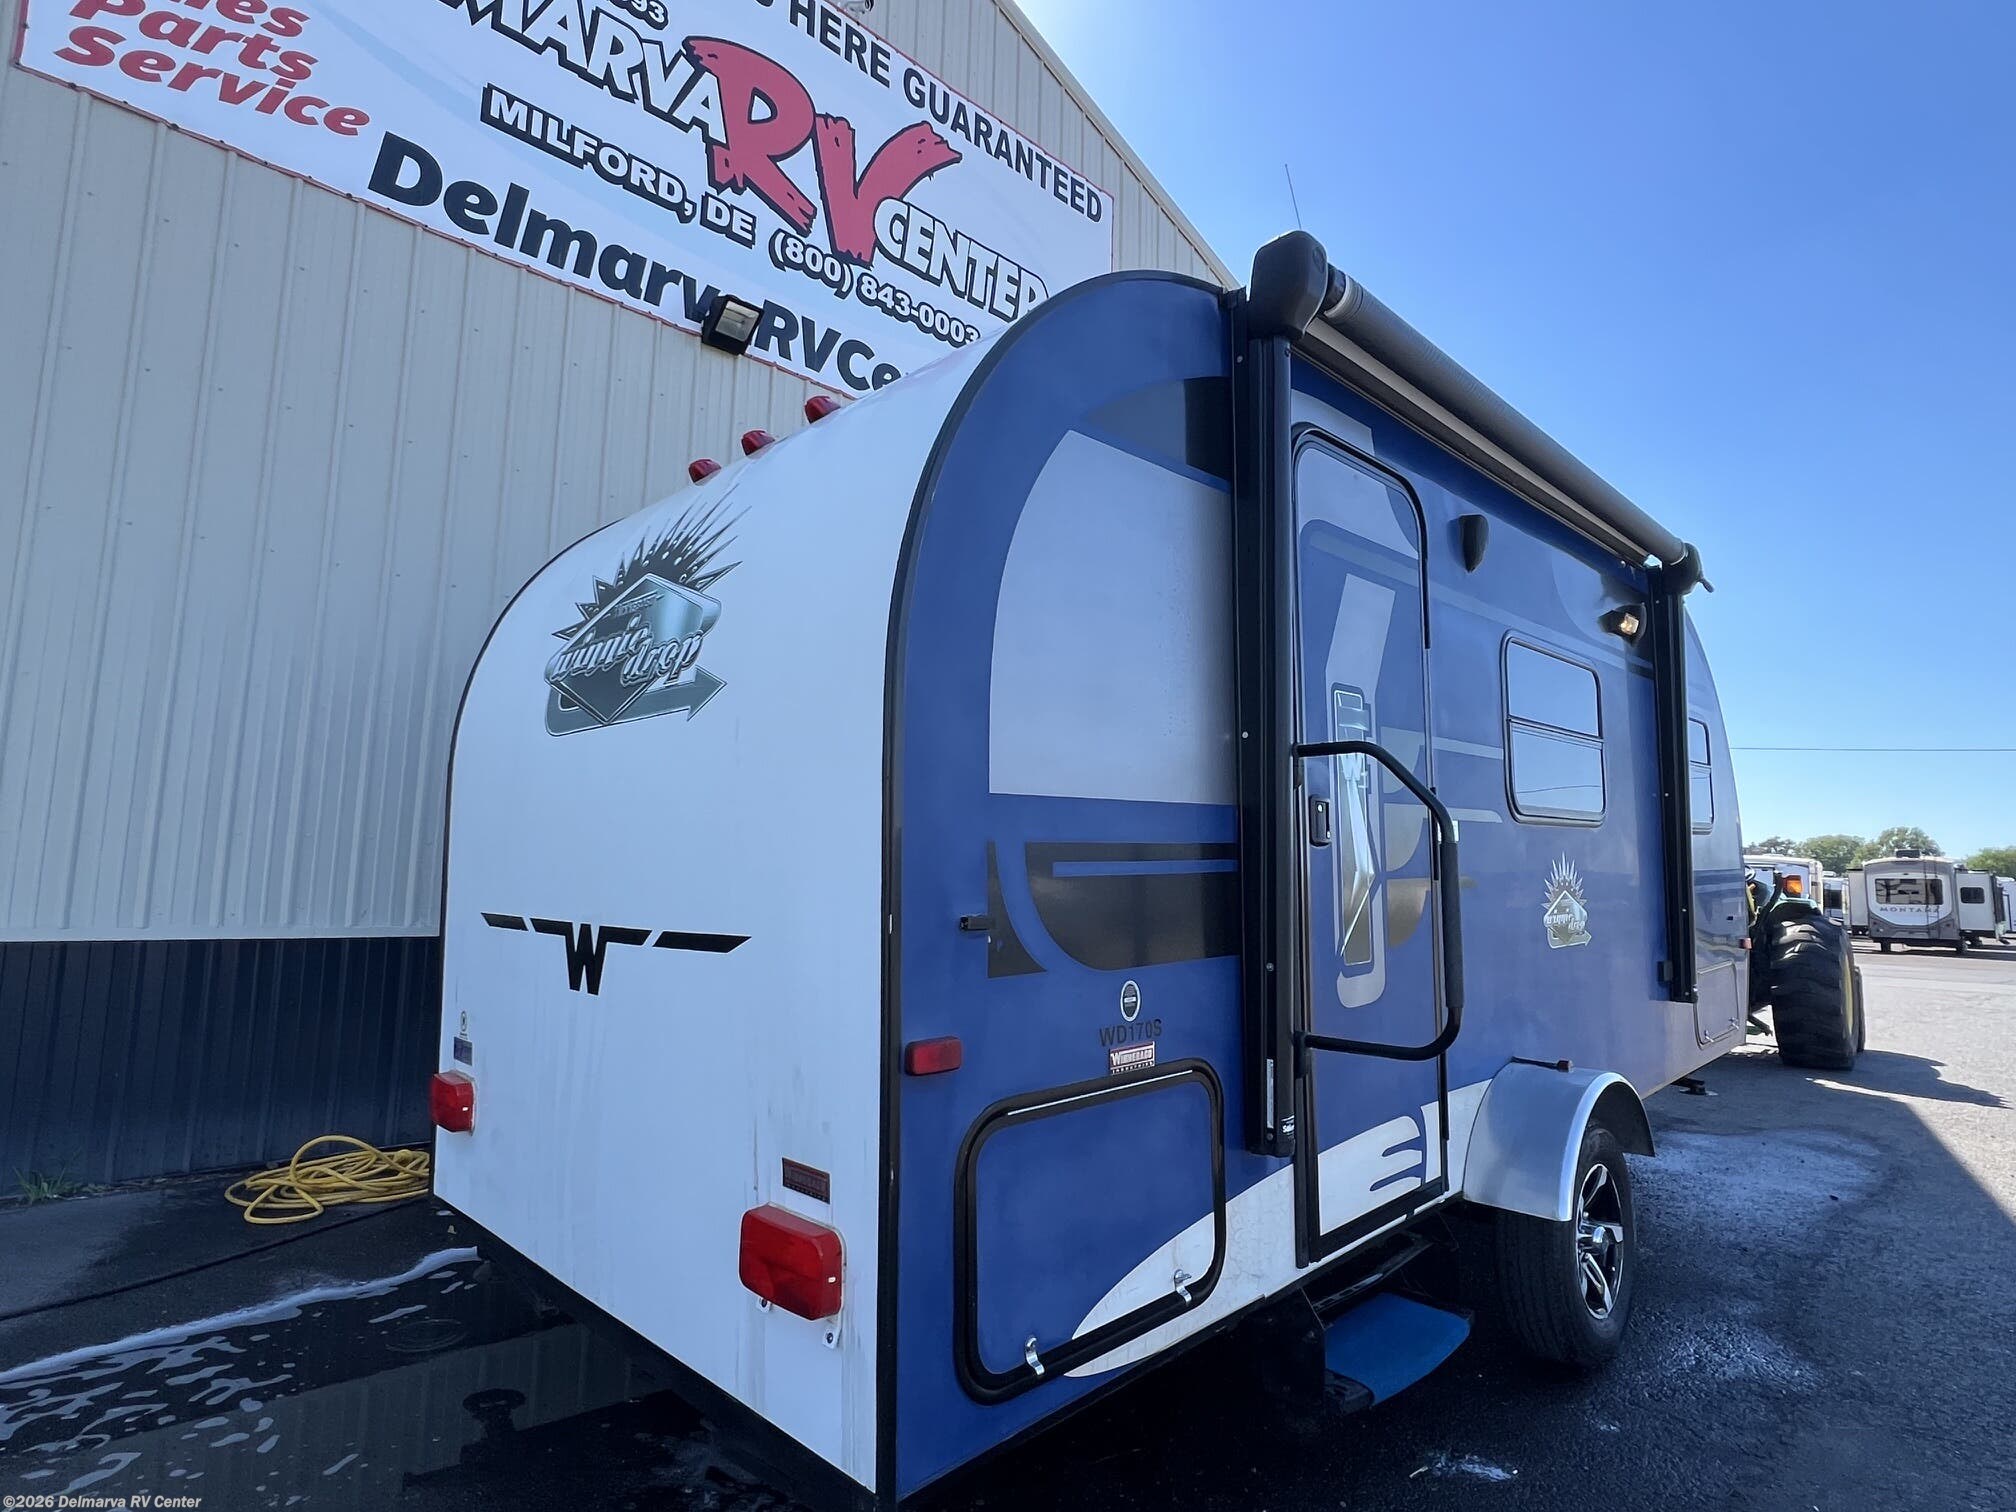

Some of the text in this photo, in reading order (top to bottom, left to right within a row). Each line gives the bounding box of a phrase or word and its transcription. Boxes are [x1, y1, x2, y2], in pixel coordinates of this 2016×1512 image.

[53, 25, 370, 136] Service
[681, 35, 963, 268] RV
[788, 0, 1103, 223] HERE GUARANTEED
[484, 84, 696, 220] MILFORD,
[702, 193, 755, 246] DE
[770, 229, 852, 296] (800)
[1100, 1019, 1162, 1046] WD170S
